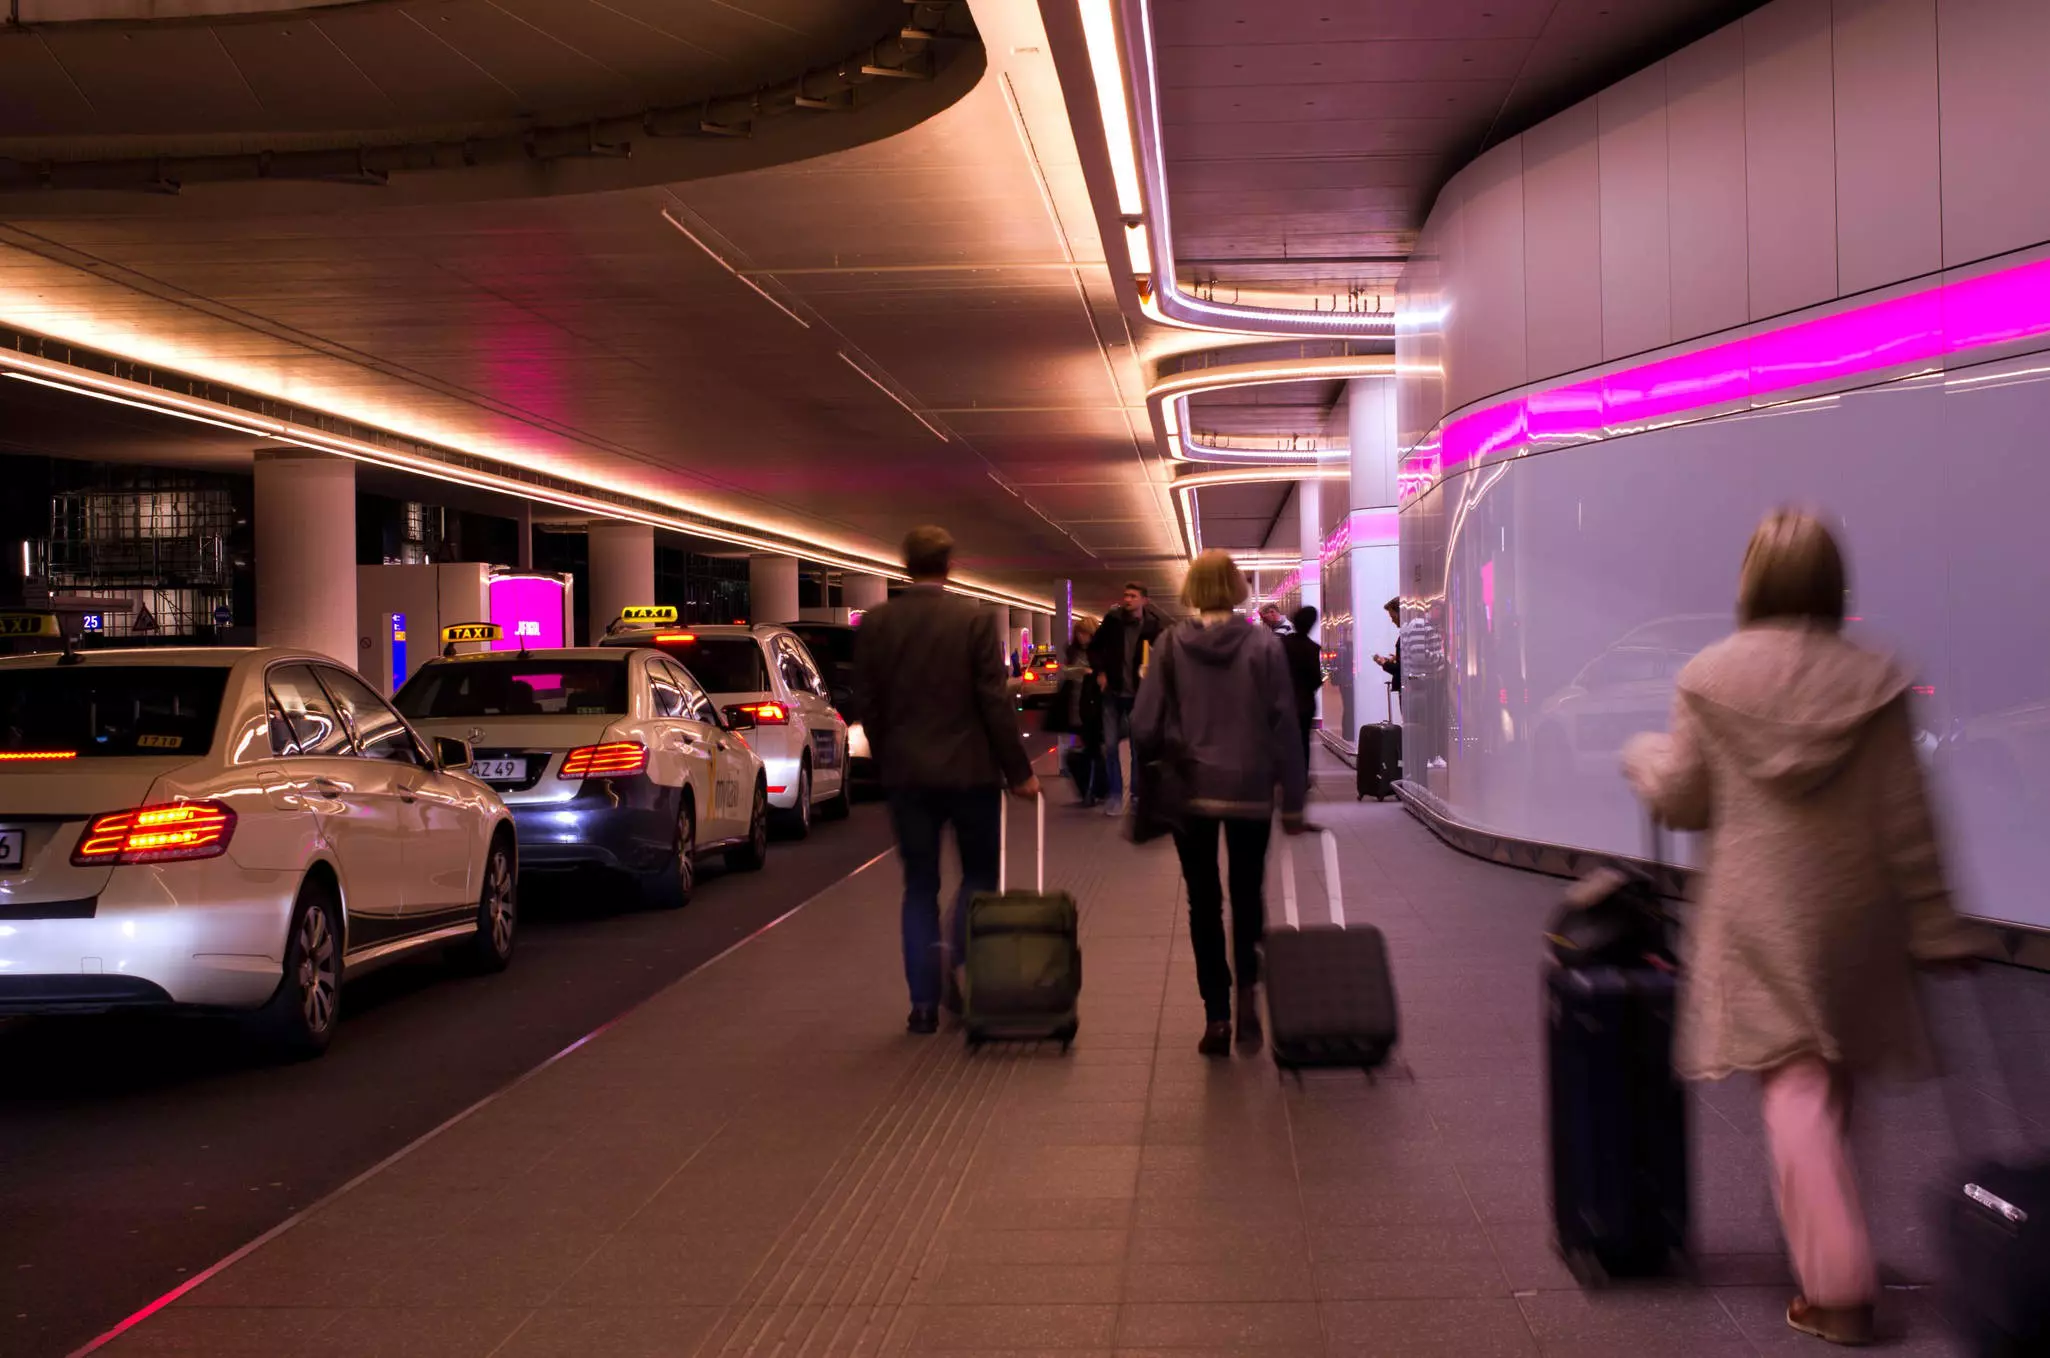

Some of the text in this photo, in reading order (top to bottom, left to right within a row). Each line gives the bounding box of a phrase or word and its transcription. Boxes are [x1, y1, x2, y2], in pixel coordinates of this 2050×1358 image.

[631, 608, 666, 617] TAXI
[83, 615, 98, 628] 25
[453, 627, 488, 639] TAXI
[495, 761, 515, 776] 49
